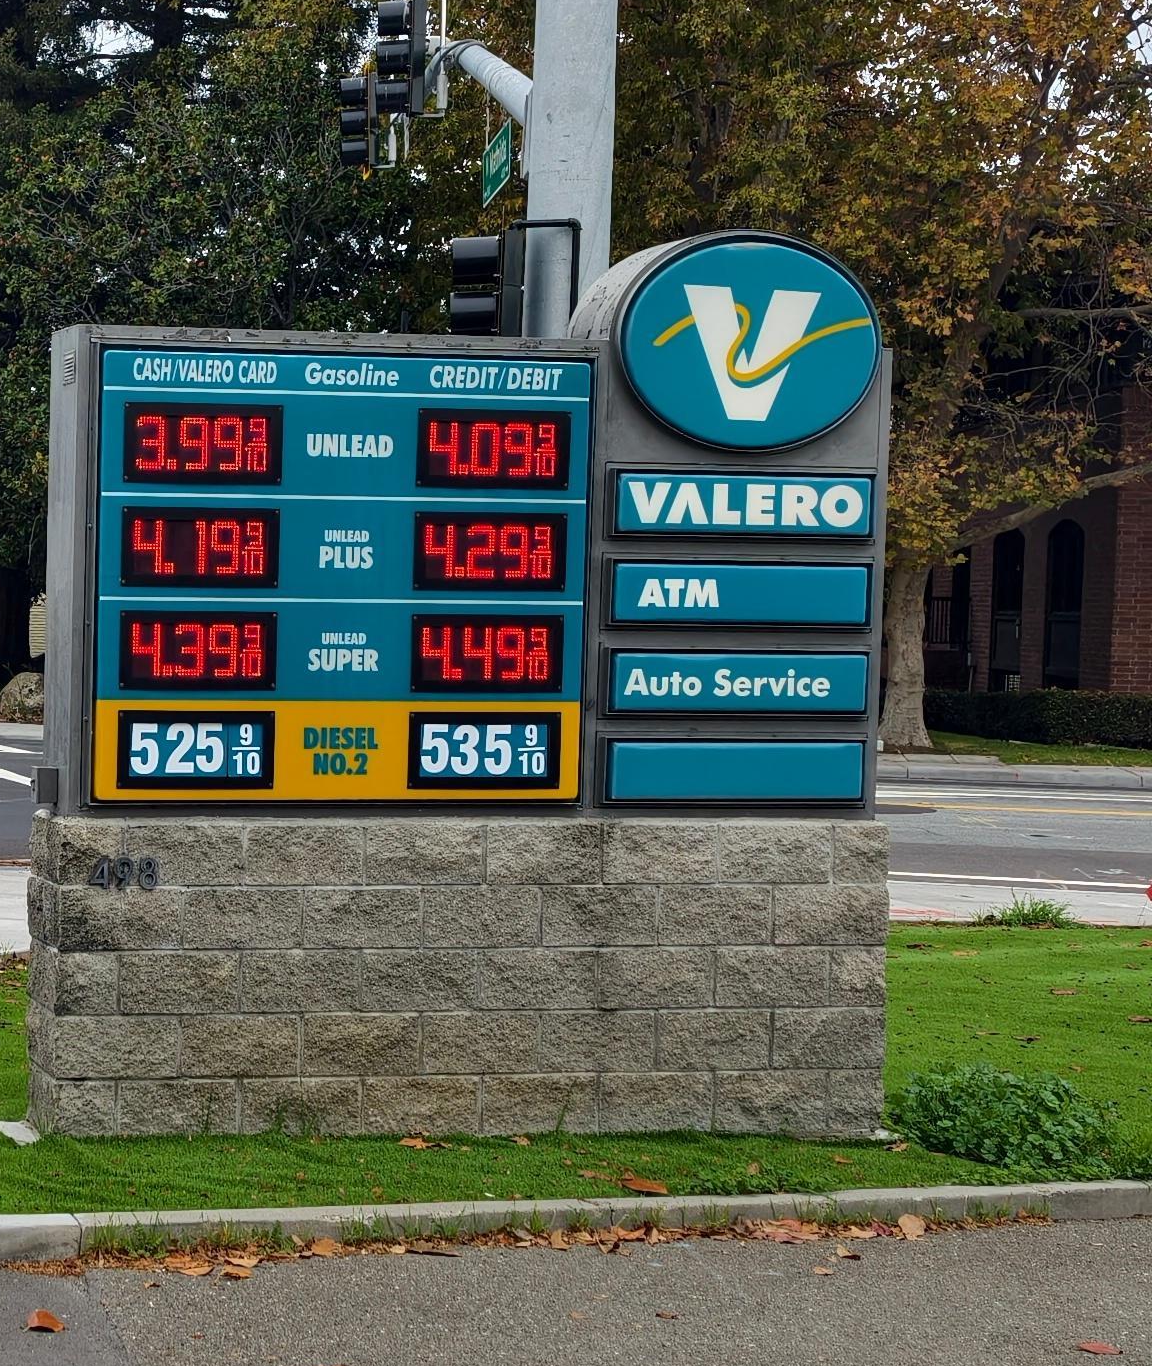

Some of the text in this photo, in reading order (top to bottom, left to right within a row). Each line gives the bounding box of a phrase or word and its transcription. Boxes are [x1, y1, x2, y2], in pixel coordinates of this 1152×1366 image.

[133, 357, 278, 384] CASH/VALERO CARD
[304, 362, 400, 387] Gasoline
[429, 365, 563, 391] CREDIT/DEBIT
[136, 415, 243, 471] 3.99
[306, 433, 394, 458] UNLEAD
[429, 422, 533, 476] 4.09
[628, 481, 864, 528] VALERO
[134, 519, 239, 574] 4.19
[324, 529, 370, 543] UNLEAD
[319, 546, 374, 570] PLUS
[424, 525, 528, 578] 4.29
[637, 578, 720, 608] ATM
[132, 623, 237, 677] 4.39
[321, 632, 367, 645] UNLEAD
[422, 627, 525, 680] 4.49
[307, 648, 379, 672] SUPER
[623, 668, 831, 698] Auto Service
[130, 722, 224, 775] 525
[303, 727, 379, 750] DIESEL
[420, 723, 512, 776] 535
[312, 753, 368, 776] NO.2
[88, 856, 159, 890] 498
